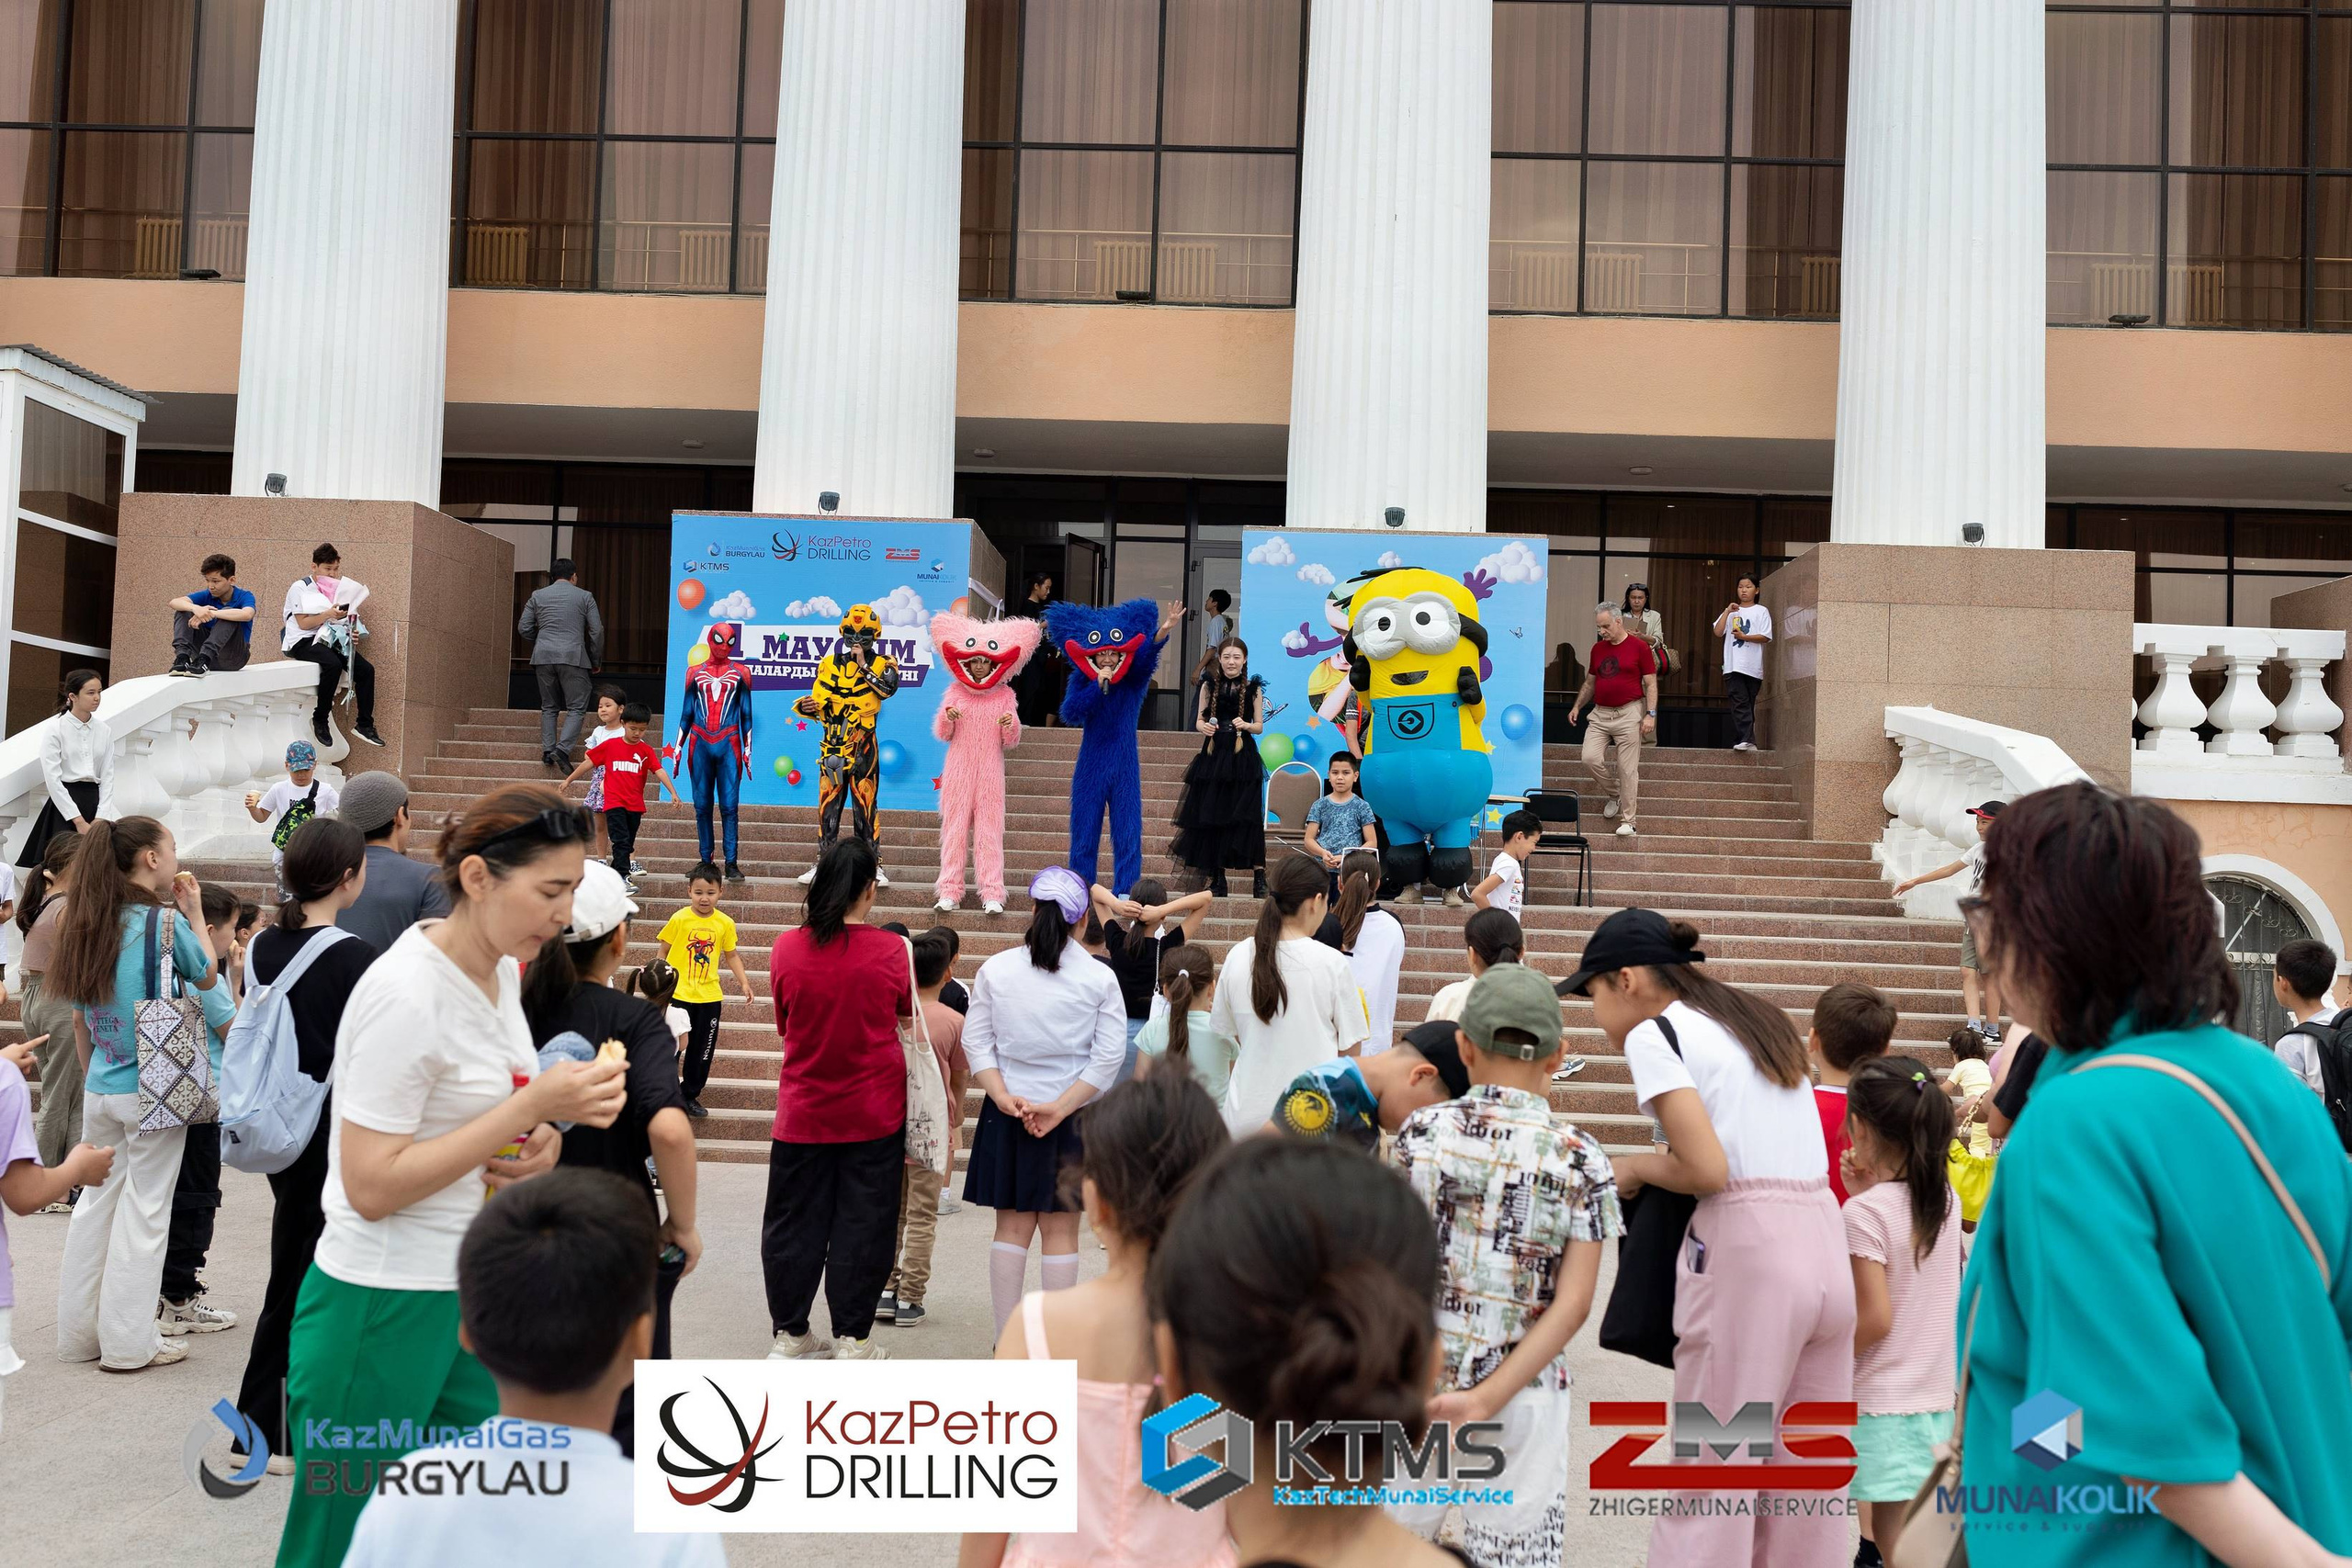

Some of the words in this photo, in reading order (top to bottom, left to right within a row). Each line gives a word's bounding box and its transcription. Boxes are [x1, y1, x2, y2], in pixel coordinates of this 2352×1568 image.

[808, 535, 872, 548] KazPetro
[725, 550, 765, 558] BURGYLAU
[808, 547, 871, 561] DRILLING
[700, 562, 729, 570] KTMS
[762, 635, 916, 664] МАУМ
[612, 761, 639, 773] PUMA
[702, 1028, 716, 1061] VUITTON
